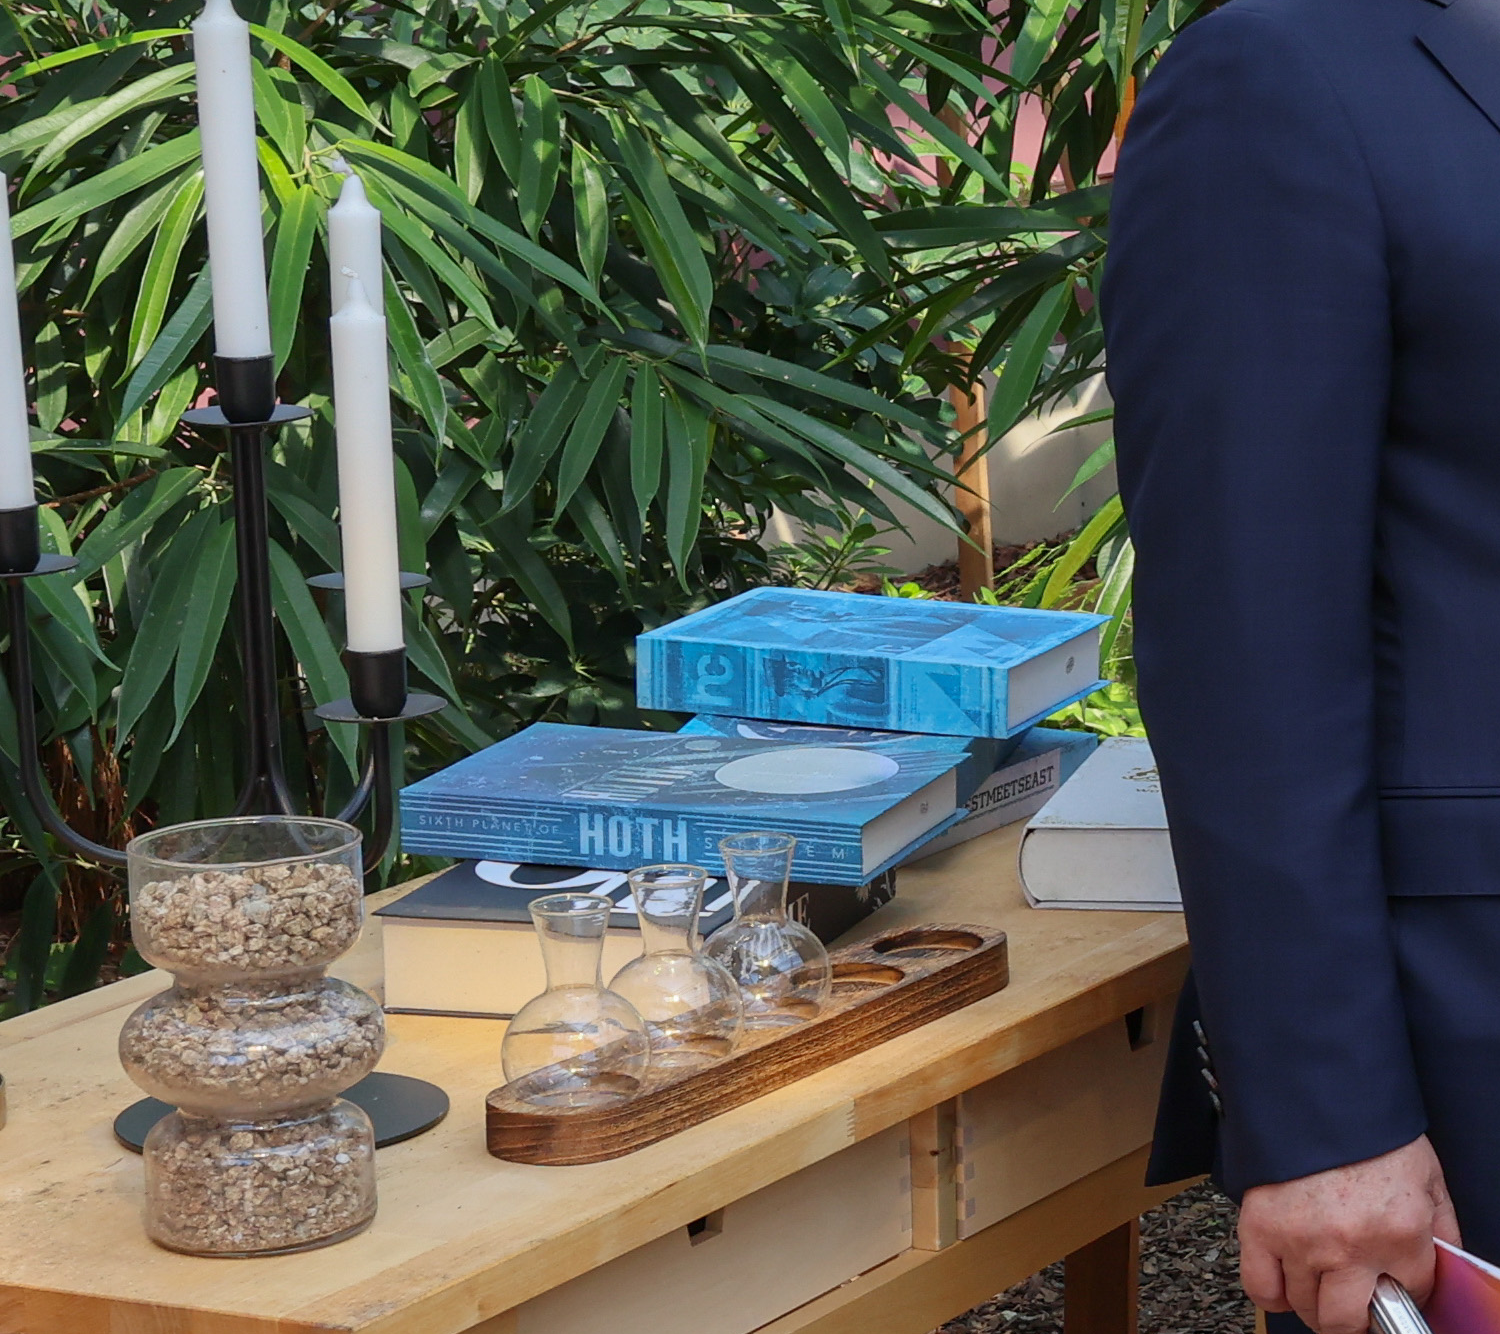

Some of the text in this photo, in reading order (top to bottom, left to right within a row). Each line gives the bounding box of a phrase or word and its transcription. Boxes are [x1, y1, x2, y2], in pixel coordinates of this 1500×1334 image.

[418, 812, 688, 863] SIXTH PLANET OF HOTH
